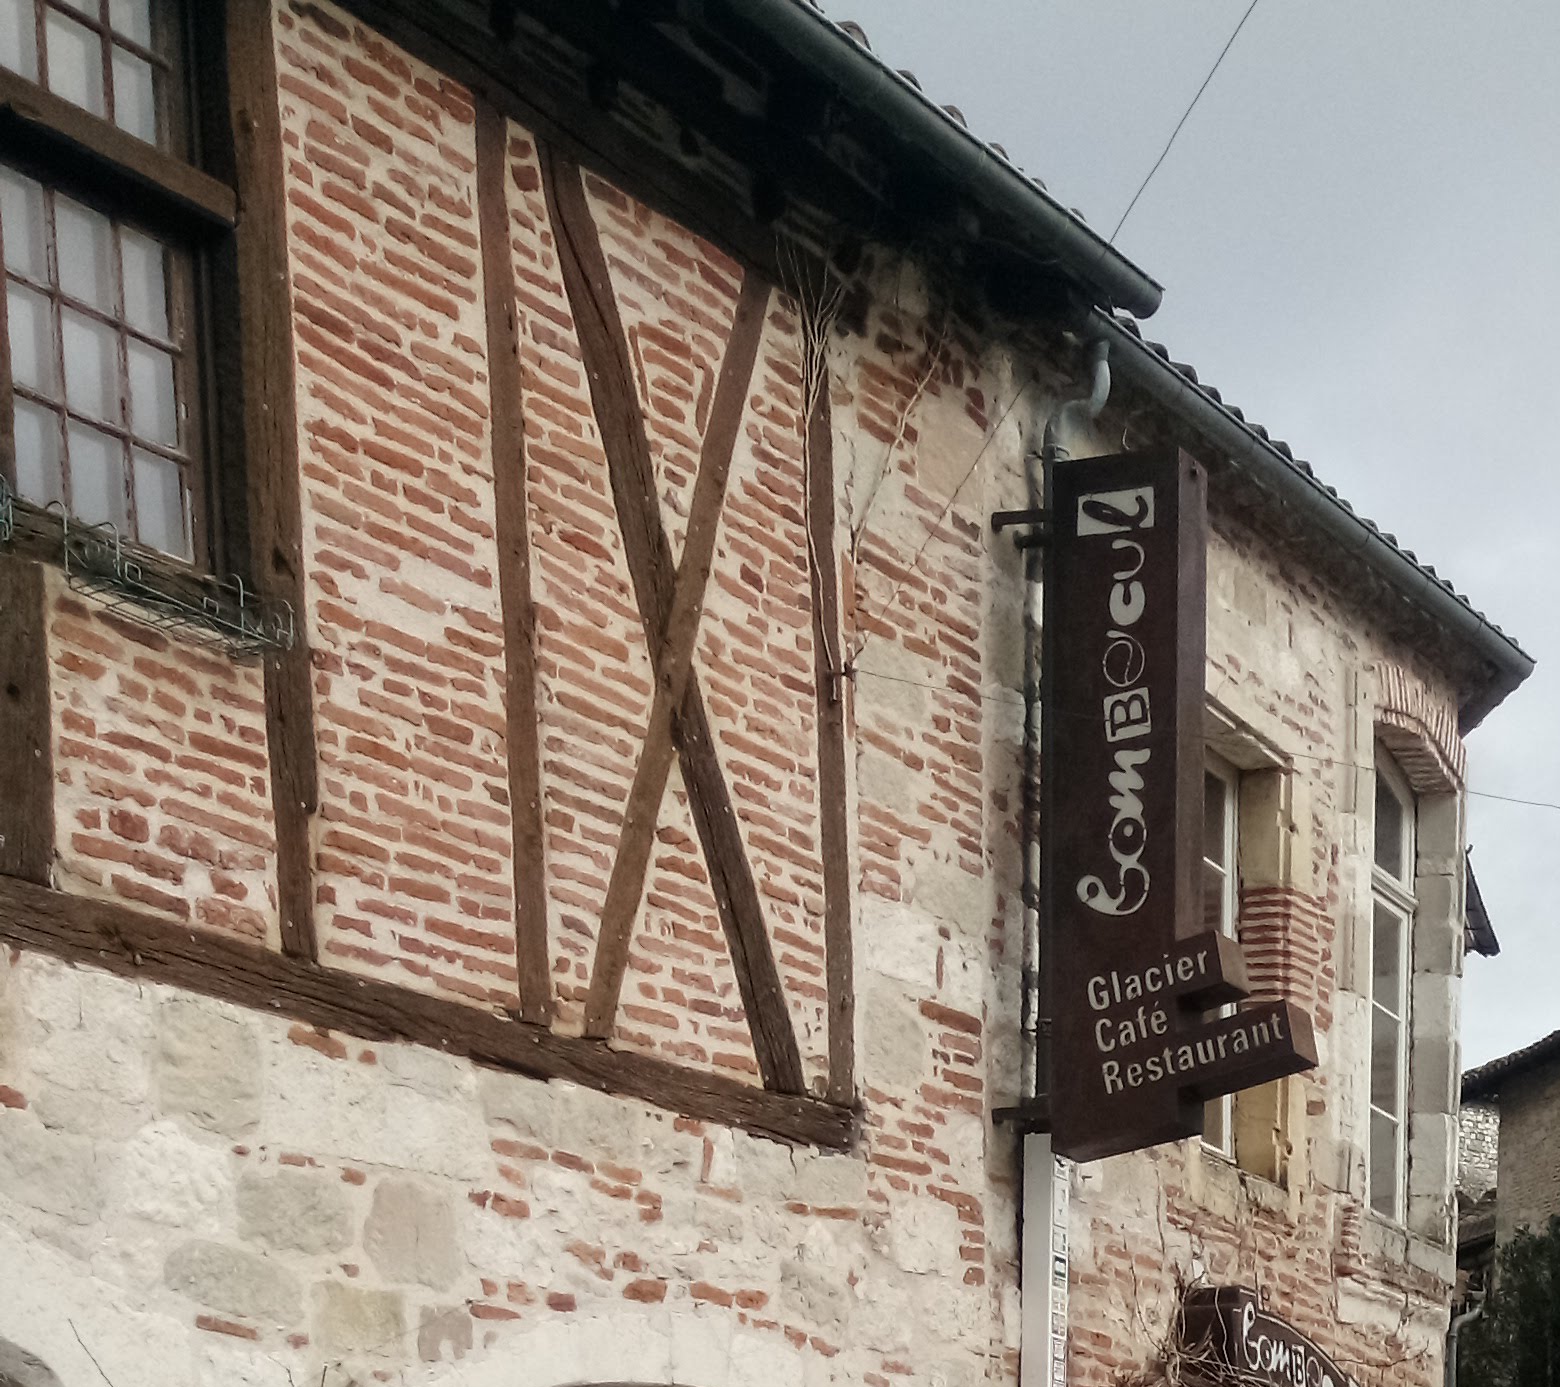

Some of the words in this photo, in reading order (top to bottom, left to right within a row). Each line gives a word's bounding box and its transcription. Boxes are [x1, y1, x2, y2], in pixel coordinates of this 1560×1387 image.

[1087, 950, 1207, 1010] Glacier
[1095, 1001, 1168, 1052] Café
[1103, 1013, 1284, 1094] Restaurant
